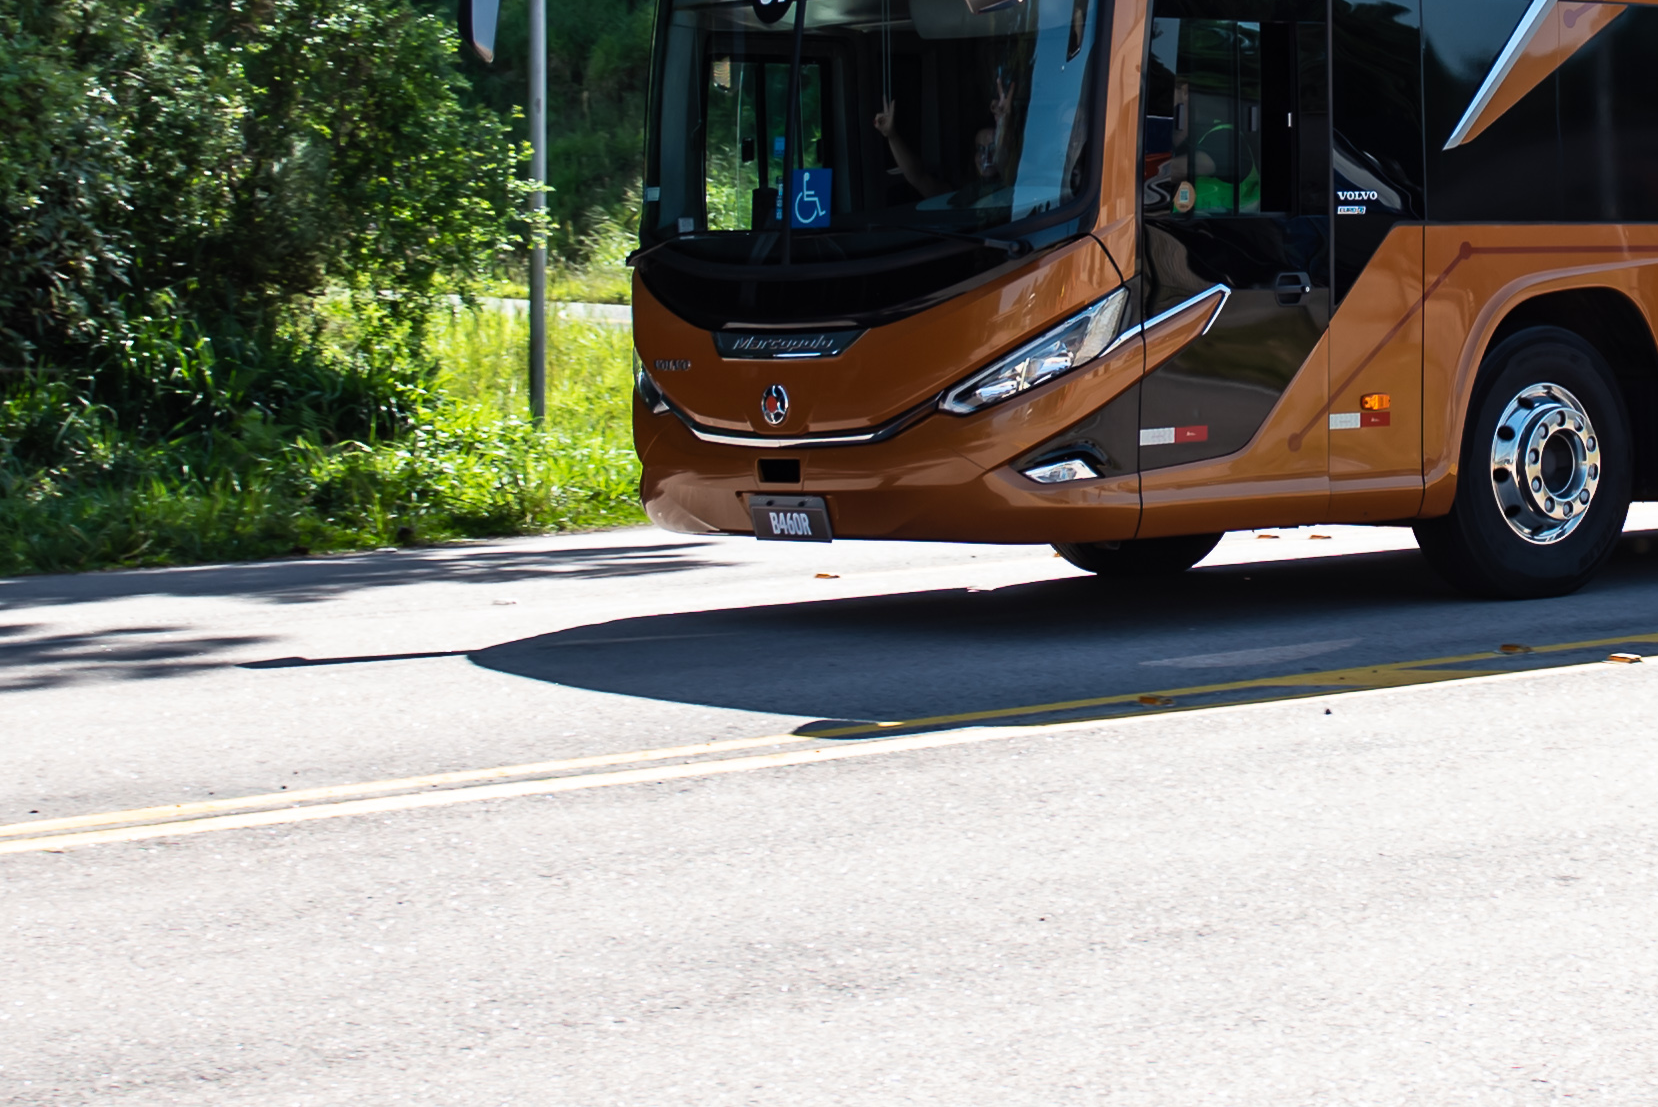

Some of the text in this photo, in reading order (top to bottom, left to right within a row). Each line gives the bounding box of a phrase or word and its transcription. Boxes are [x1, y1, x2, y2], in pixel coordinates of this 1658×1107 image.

[1337, 191, 1378, 200] VOLVO
[732, 335, 834, 352] Marcopolo
[769, 512, 812, 536] B460R
